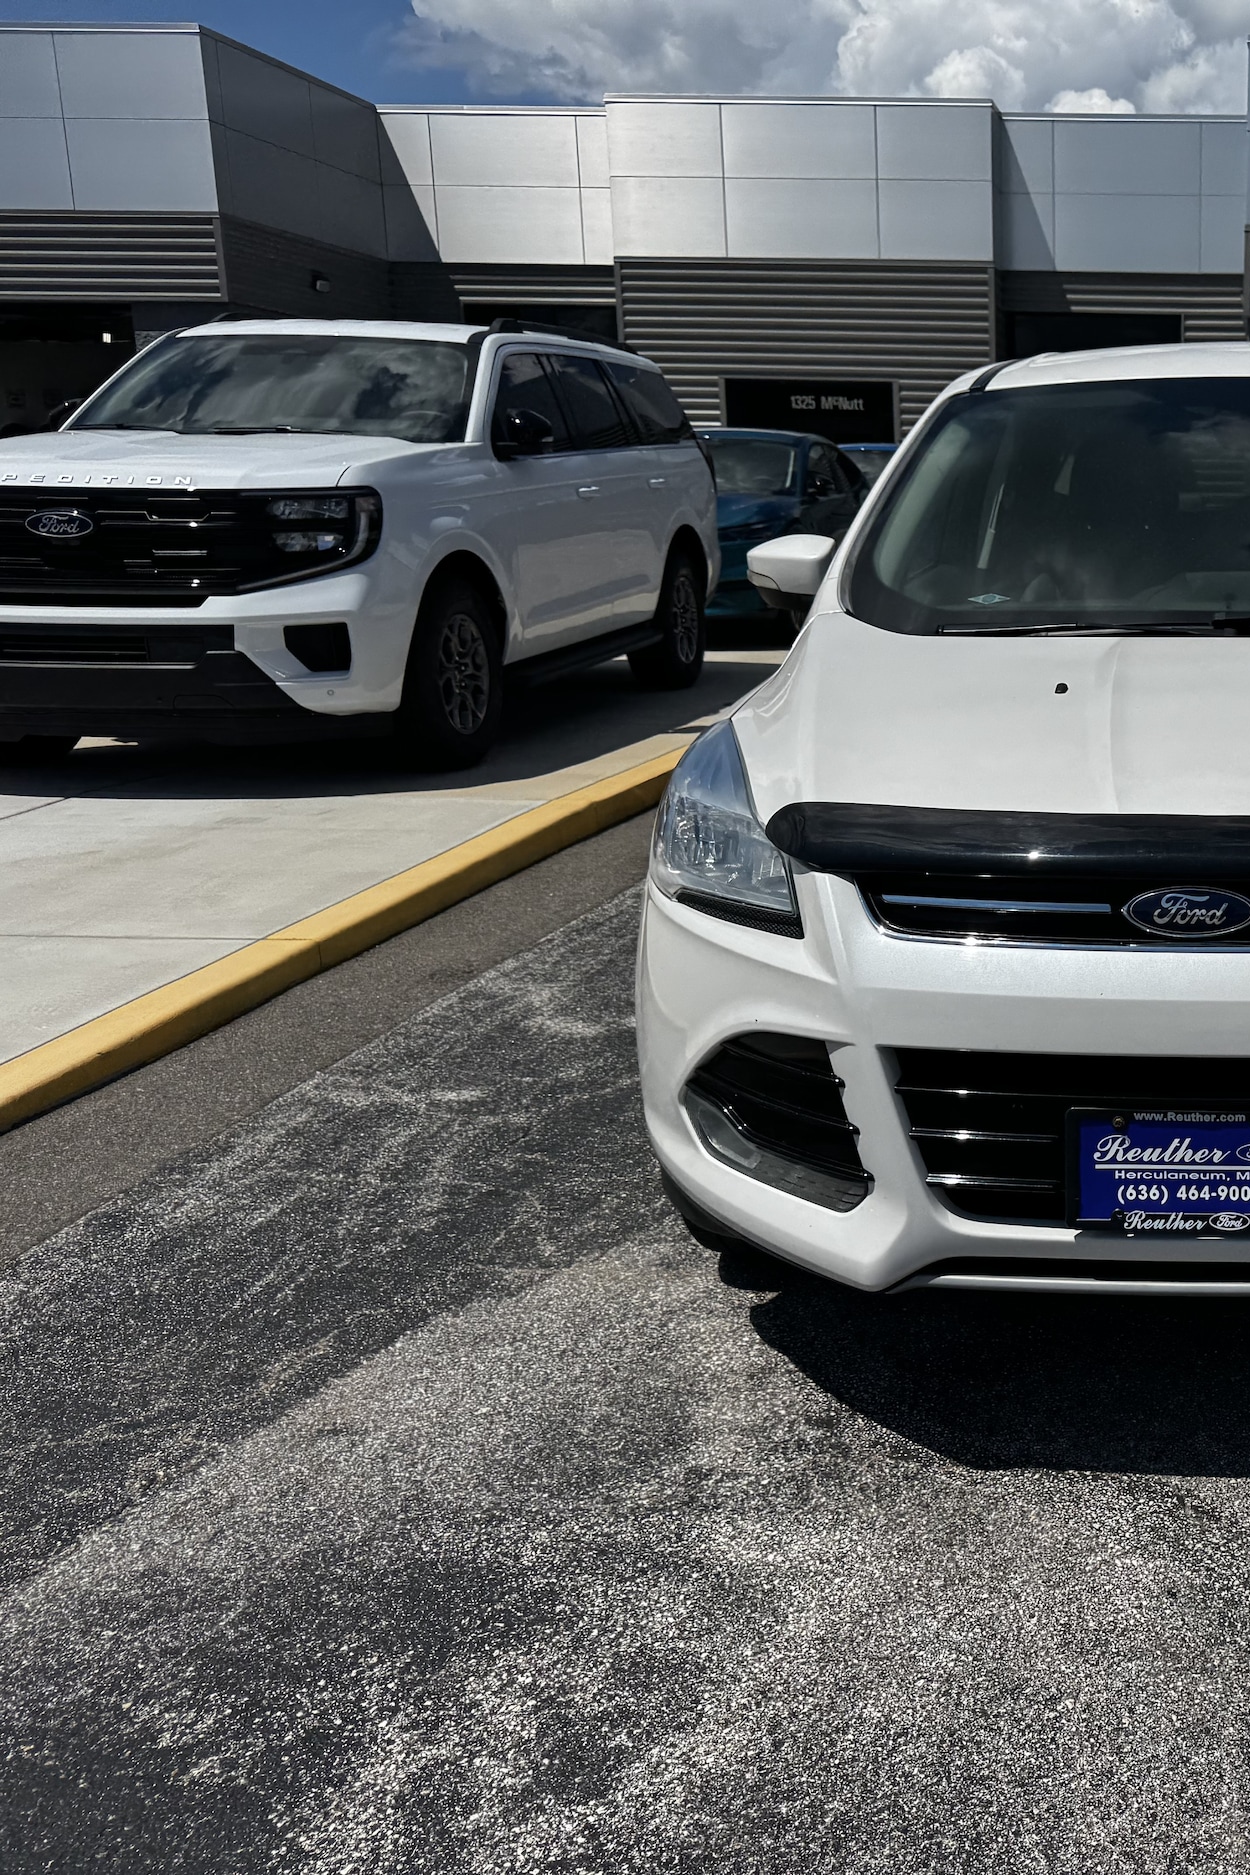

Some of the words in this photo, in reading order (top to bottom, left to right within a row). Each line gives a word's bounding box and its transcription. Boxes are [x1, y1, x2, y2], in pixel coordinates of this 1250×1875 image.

[790, 395, 816, 410] 1325
[820, 396, 865, 411] McNutt
[38, 515, 80, 535] Ford
[1153, 893, 1229, 925] Ford
[1133, 1111, 1246, 1123] www.Reuther.com
[1093, 1134, 1232, 1163] Reuther
[1114, 1170, 1231, 1182] Herculaneum,
[1117, 1185, 1169, 1204] (636)
[1123, 1210, 1208, 1230] Reuther
[1216, 1213, 1244, 1228] Ford
